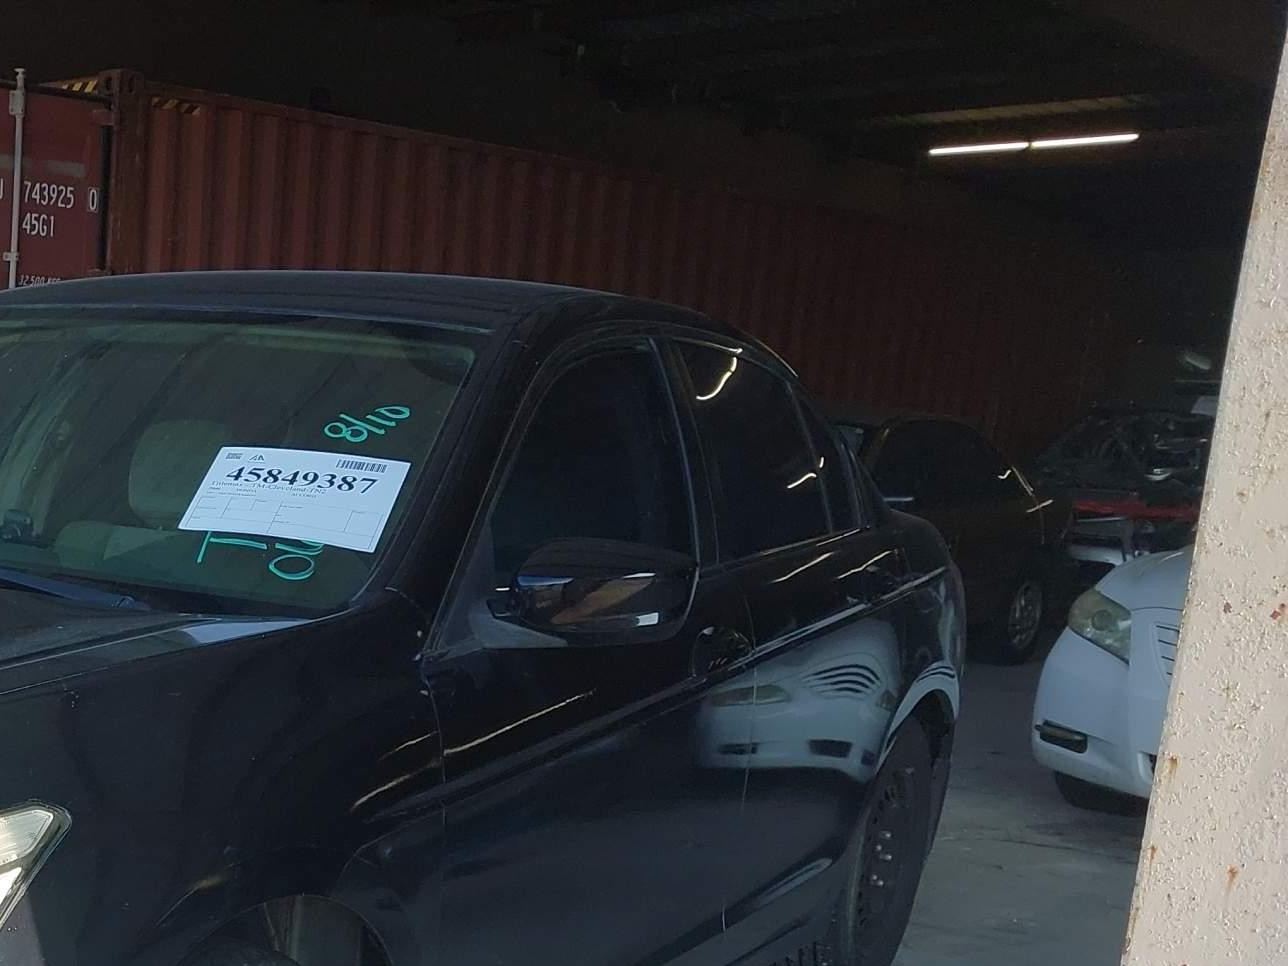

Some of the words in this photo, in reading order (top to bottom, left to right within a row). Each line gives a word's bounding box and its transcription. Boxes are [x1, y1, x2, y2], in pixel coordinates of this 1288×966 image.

[24, 181, 74, 208] 743925
[89, 188, 98, 211] 0
[22, 212, 54, 237] 45G1
[226, 466, 379, 494] 45849387
